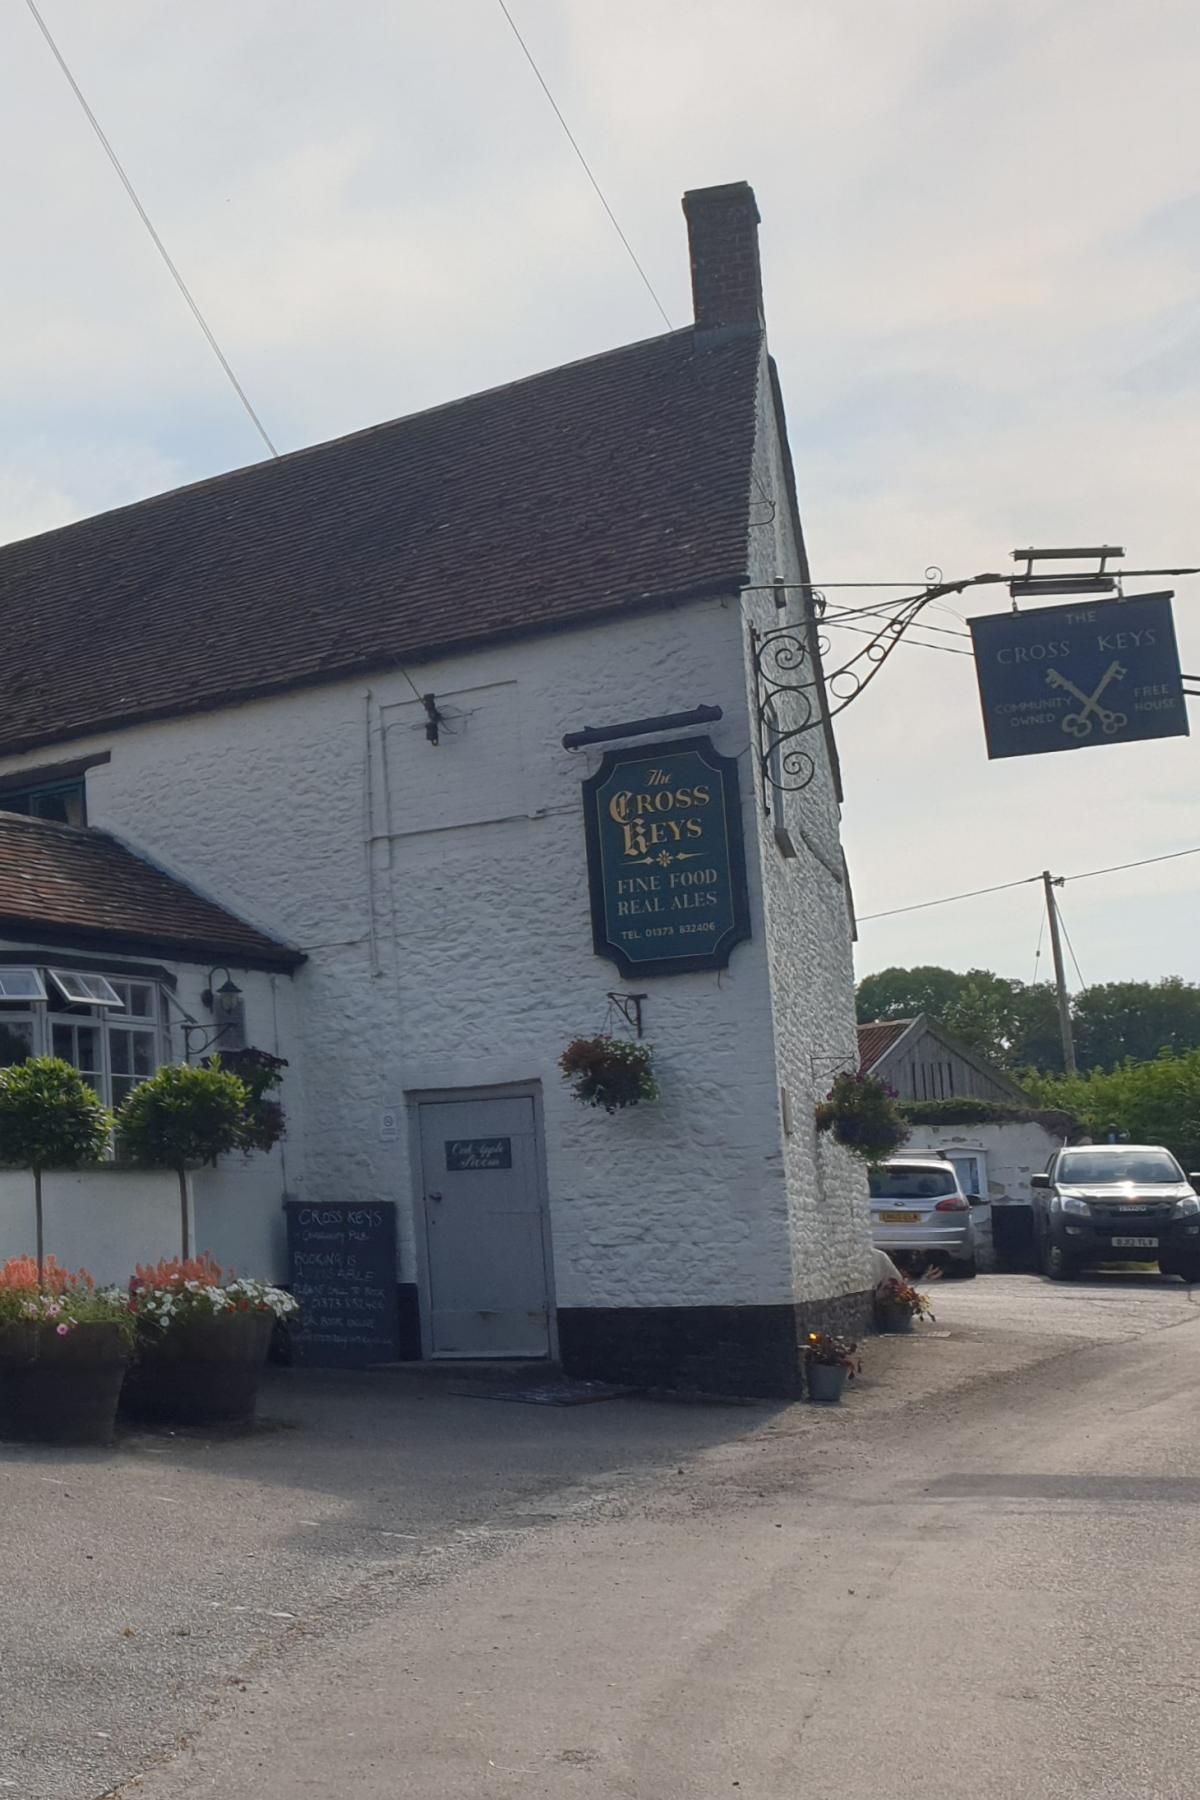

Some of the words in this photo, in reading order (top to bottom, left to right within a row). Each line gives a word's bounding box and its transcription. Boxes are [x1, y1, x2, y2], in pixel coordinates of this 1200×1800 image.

[1065, 611, 1097, 625] THE
[997, 640, 1071, 665] CROSS
[1096, 629, 1156, 652] KEYS
[1134, 684, 1169, 697] FREE
[994, 696, 1073, 714] COMMUNITY
[1134, 698, 1176, 713] HOUSE
[1010, 714, 1056, 727] OWNED
[647, 769, 672, 786] The
[609, 785, 710, 824] CROSS
[623, 818, 702, 856] KEYS
[618, 876, 661, 894] FINE
[670, 869, 717, 889] FOOD
[618, 899, 665, 915] REAL
[670, 891, 717, 911] ALES
[298, 1208, 343, 1226] CROSS
[347, 1208, 384, 1228] KEYS
